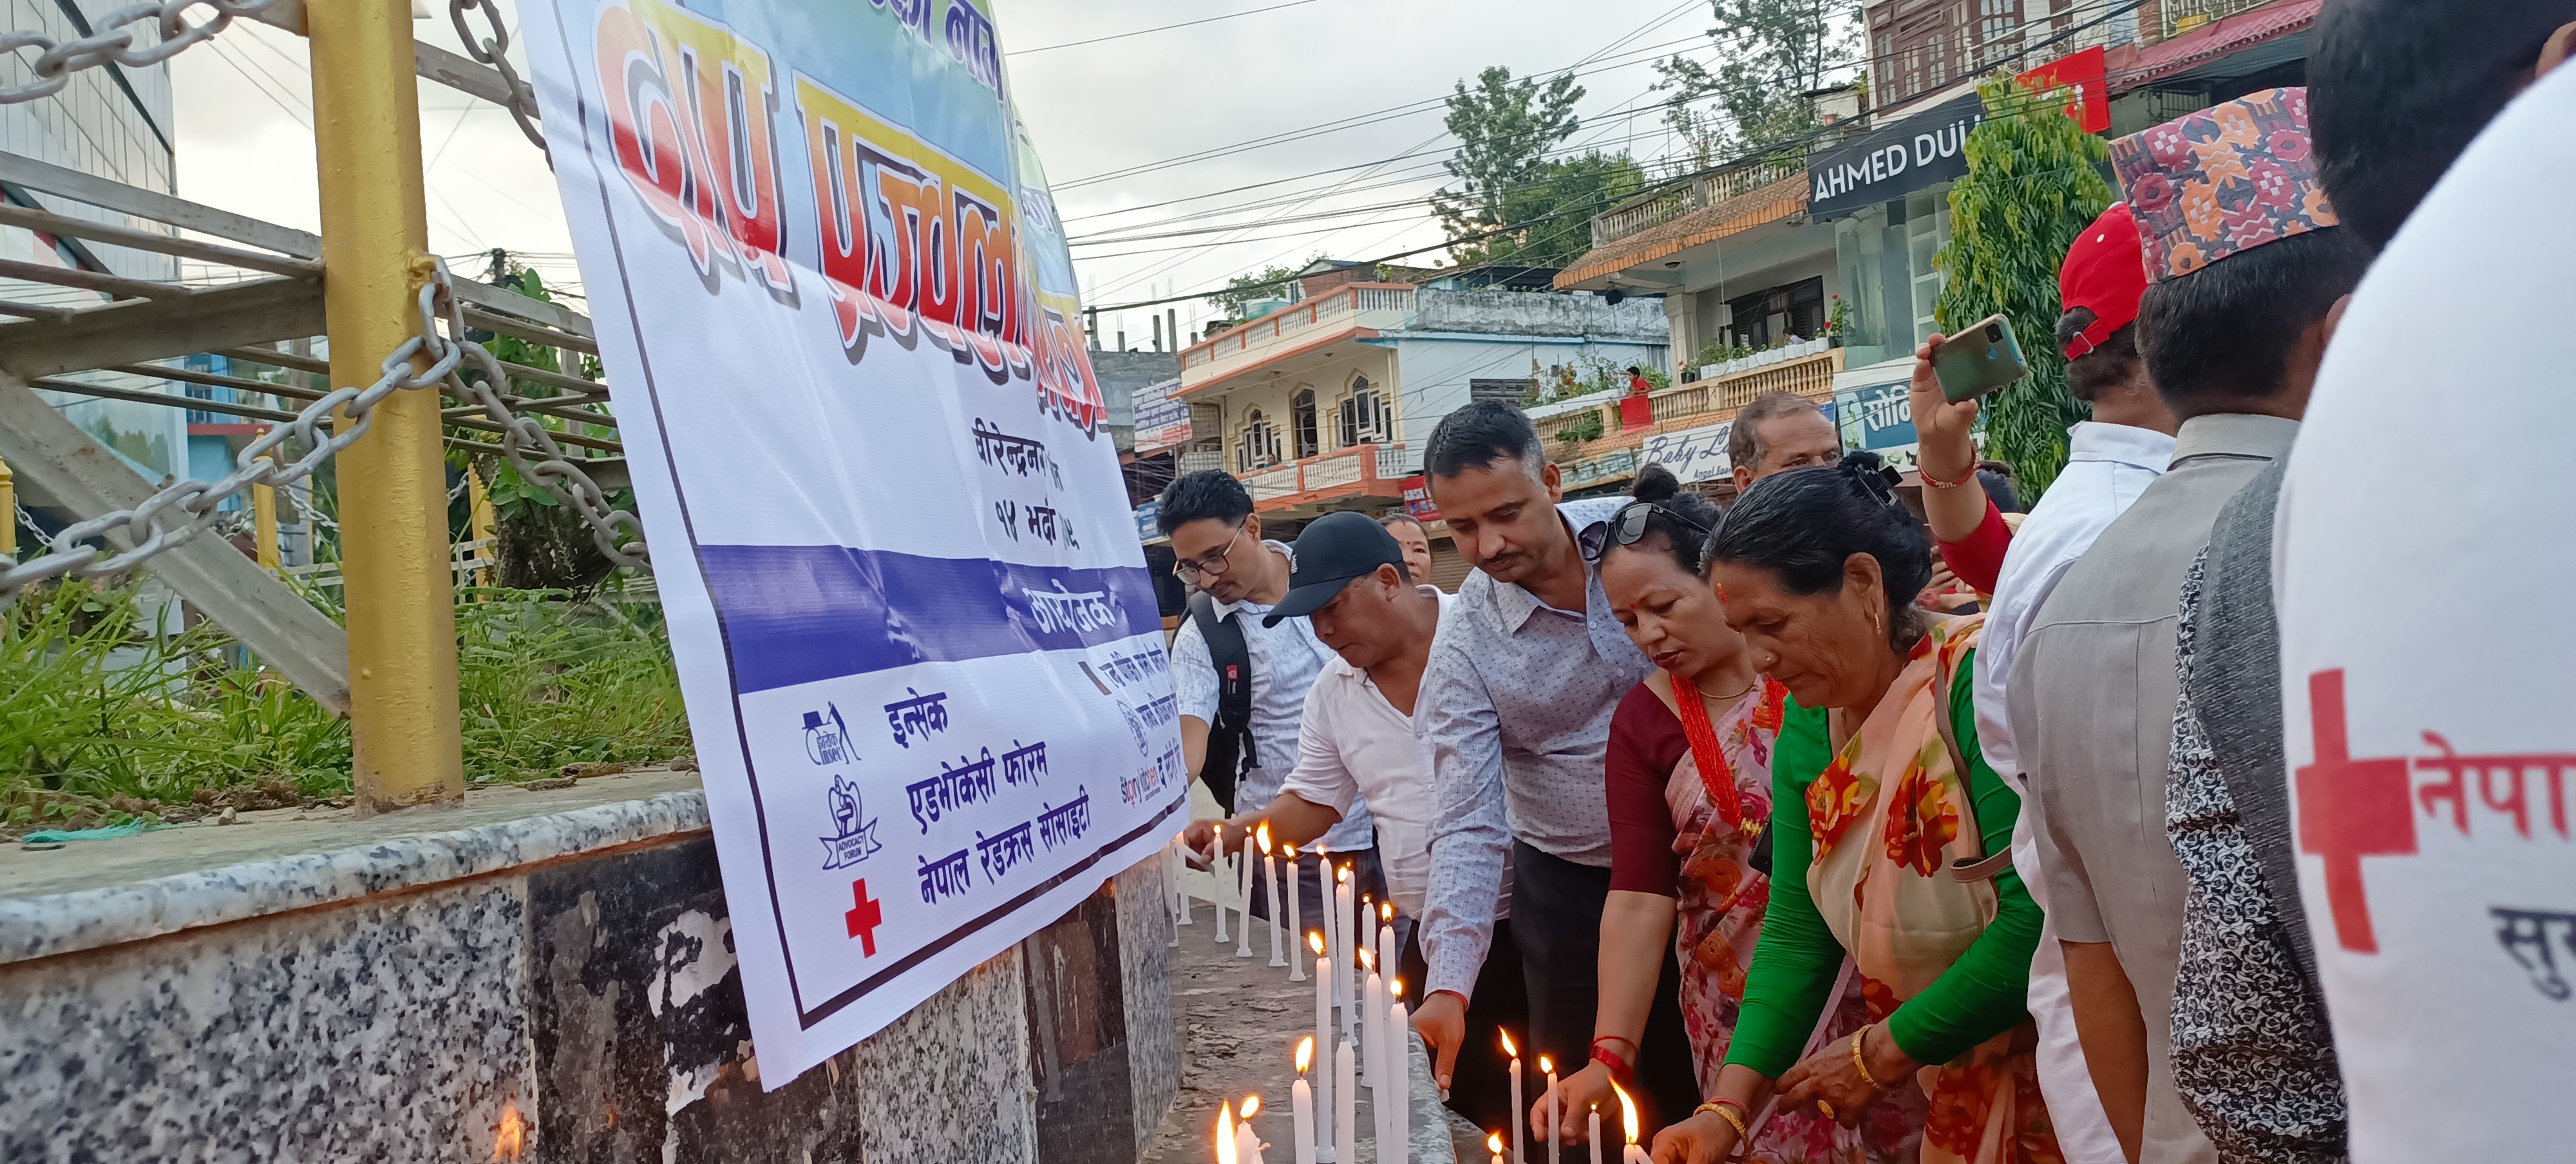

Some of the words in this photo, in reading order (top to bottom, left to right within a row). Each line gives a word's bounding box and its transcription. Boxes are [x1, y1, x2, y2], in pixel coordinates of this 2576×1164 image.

[1814, 144, 1908, 203] AHMED
[1645, 435, 1697, 474] Baby
[995, 499, 1018, 544] १४
[1022, 578, 1117, 636] आयोजक
[884, 686, 948, 749] इन्सेक
[905, 746, 996, 836] एडभोकेसी
[1001, 739, 1048, 788] फोरम
[2415, 729, 2576, 841] नेपा
[838, 834, 864, 852] ADVOCACY
[844, 847, 862, 861] FORUM
[918, 854, 971, 906] नेपाल
[976, 831, 1034, 886] रेडक्रस
[1037, 784, 1092, 854] सोसाइटी
